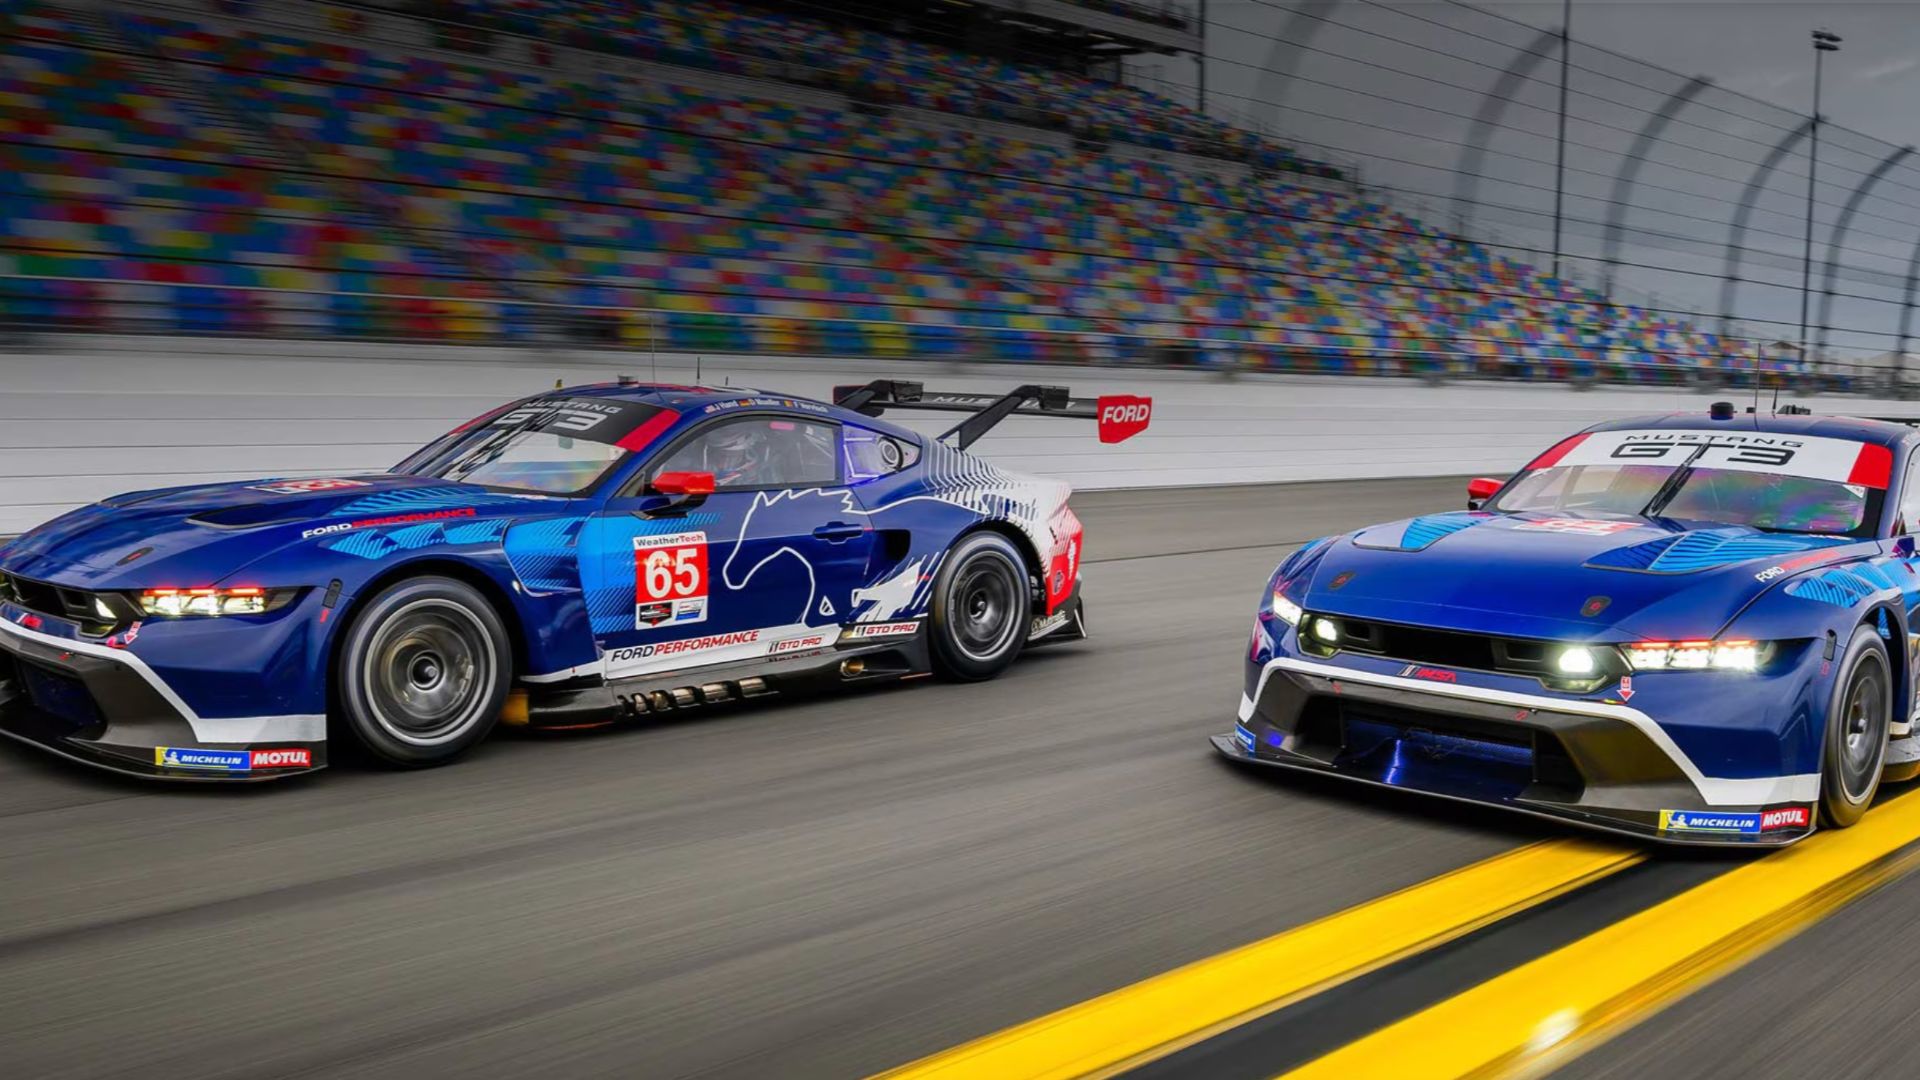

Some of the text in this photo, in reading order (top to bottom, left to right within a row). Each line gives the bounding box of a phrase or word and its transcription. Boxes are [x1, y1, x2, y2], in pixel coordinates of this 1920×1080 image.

[1102, 404, 1150, 424] FORD
[1626, 434, 1804, 448] MUSTANG
[1610, 442, 1796, 466] GT3
[637, 534, 704, 546] WeatherTech
[645, 548, 700, 599] 65
[1754, 566, 1785, 582] FORD
[892, 623, 917, 633] PRO
[181, 755, 242, 765] MICHELIN
[253, 751, 308, 765] MOTUL
[1690, 818, 1756, 828] MICHELIN
[1762, 810, 1805, 827] MOTUL
